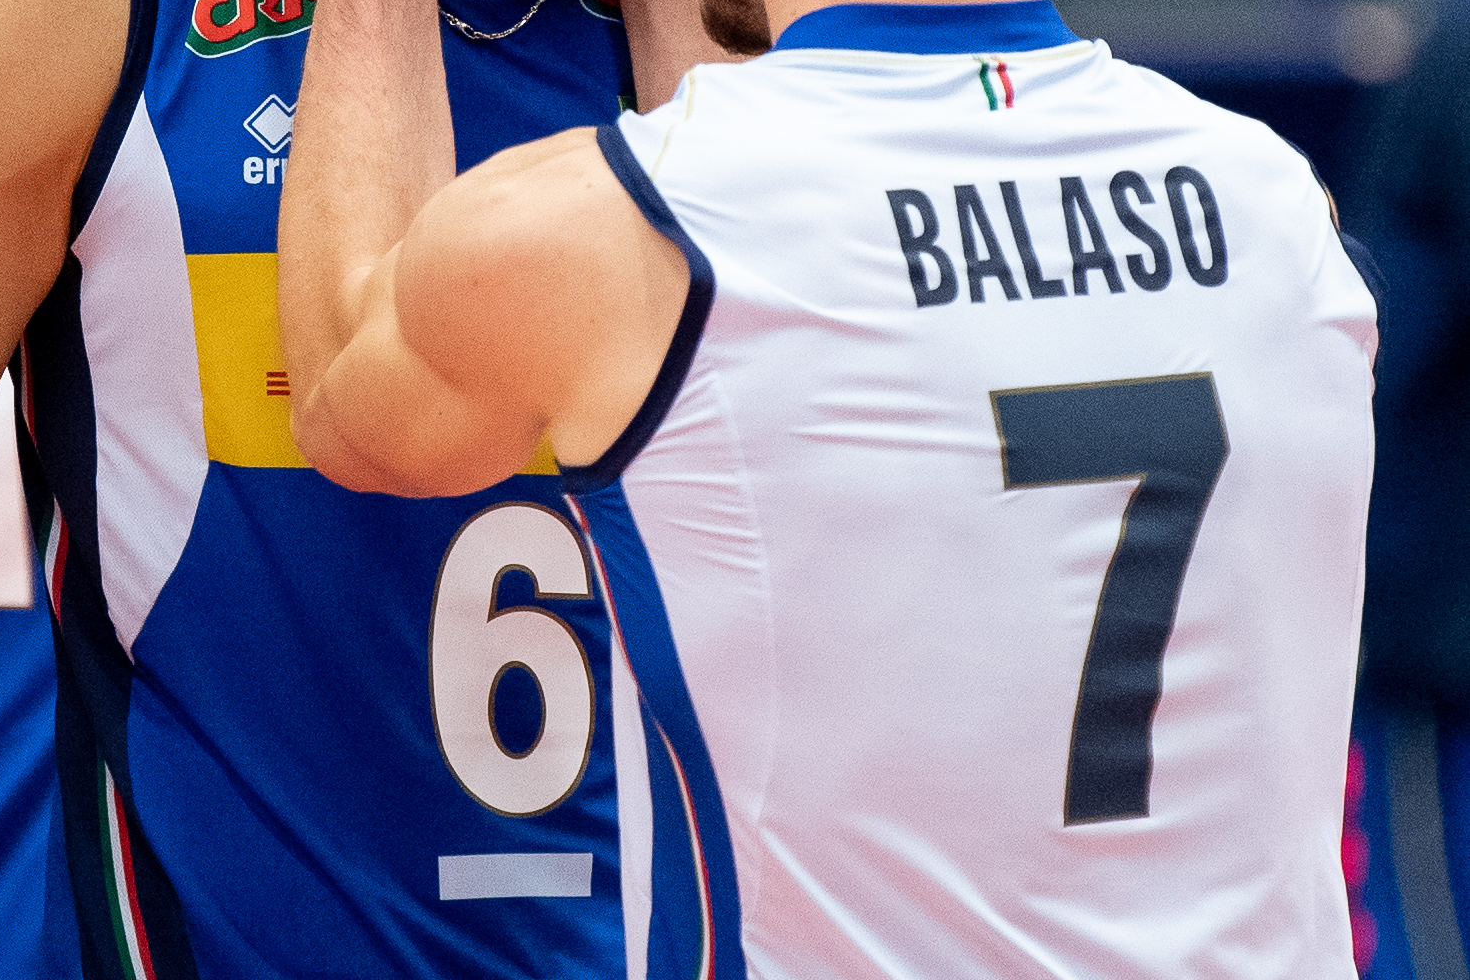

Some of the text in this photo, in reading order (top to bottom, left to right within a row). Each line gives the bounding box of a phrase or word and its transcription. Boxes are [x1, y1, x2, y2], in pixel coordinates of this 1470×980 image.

[885, 165, 1229, 308] BALASO
[429, 500, 596, 818] 6
[989, 371, 1231, 827] 7
